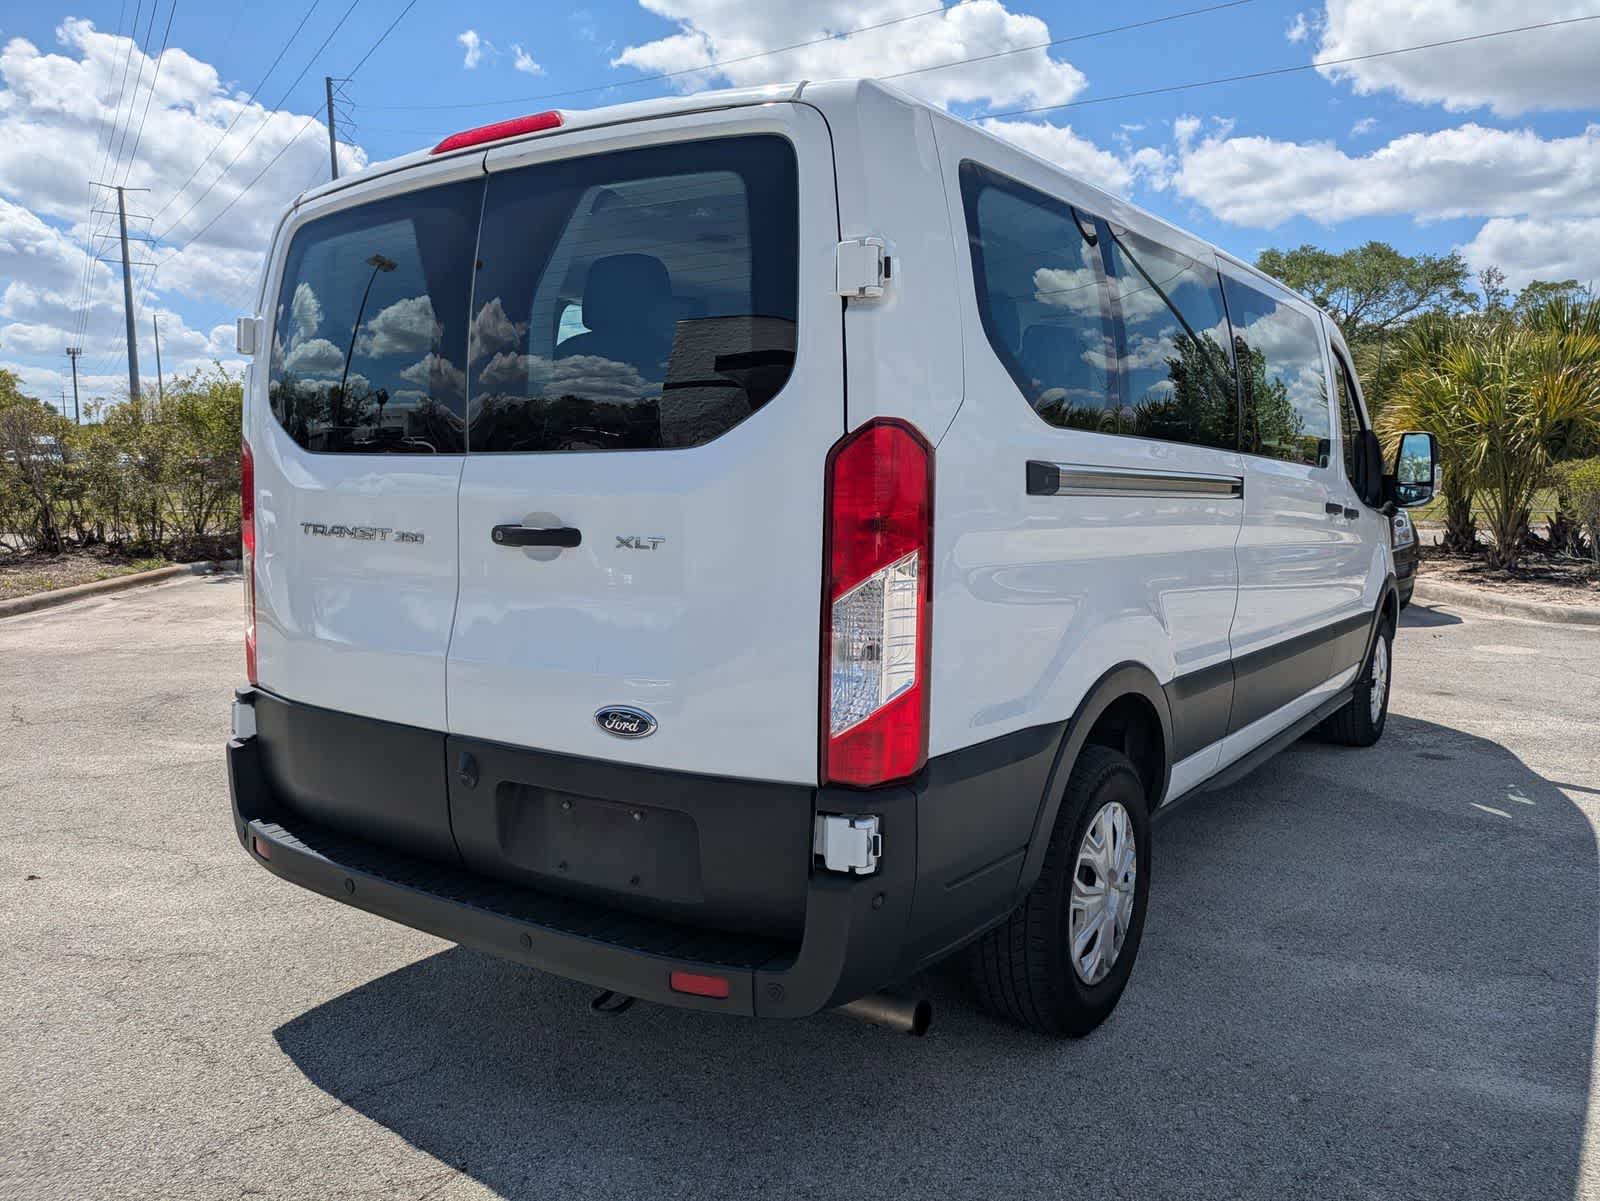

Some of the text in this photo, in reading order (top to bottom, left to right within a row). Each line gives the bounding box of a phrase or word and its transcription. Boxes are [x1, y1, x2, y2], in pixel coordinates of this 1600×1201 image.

[299, 521, 393, 541] TRANSIT
[615, 535, 666, 550] XLT
[605, 712, 640, 732] Ford
